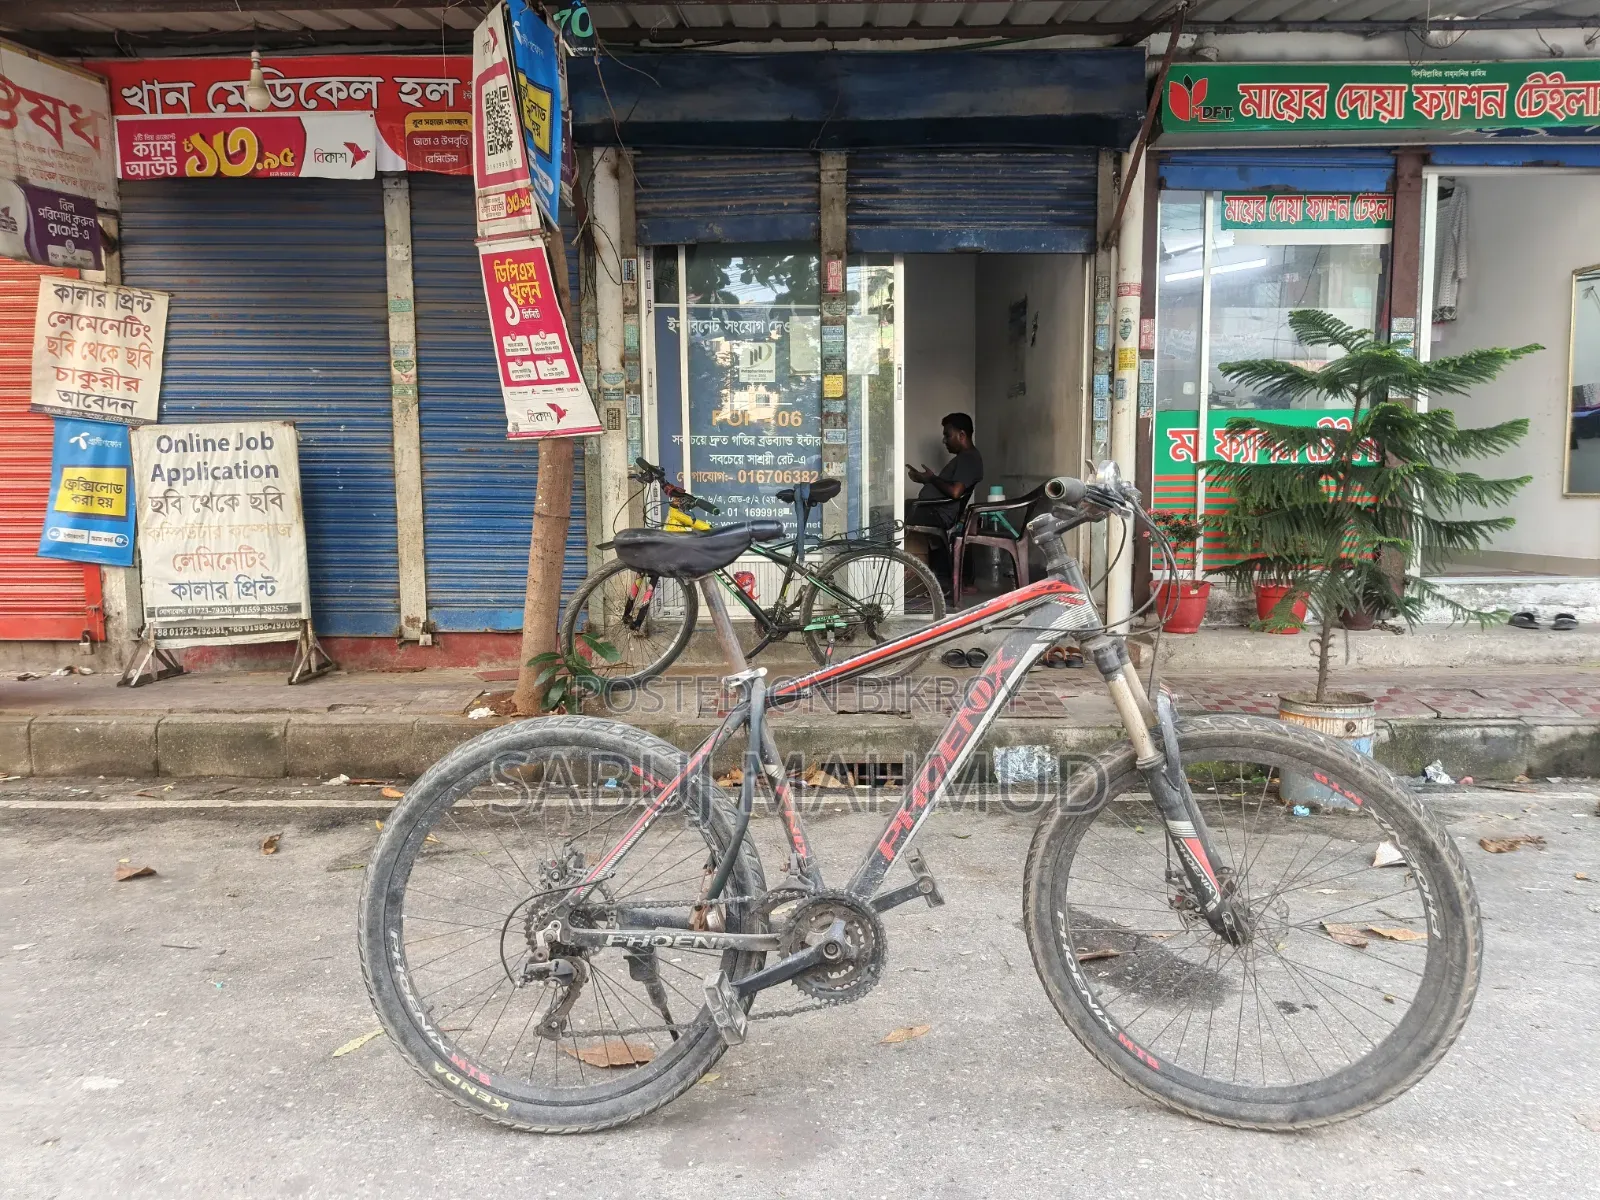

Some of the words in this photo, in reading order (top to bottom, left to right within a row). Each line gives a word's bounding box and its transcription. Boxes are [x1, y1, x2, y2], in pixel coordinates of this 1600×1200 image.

[121, 79, 196, 115] খান
[393, 77, 461, 108] হল
[1238, 83, 1329, 123] মায়ের
[1335, 83, 1408, 123] দোয়া
[1411, 83, 1509, 120] ফ্যাশন
[133, 141, 176, 157] ক্যাশ
[313, 148, 347, 163] বিকাশ
[125, 157, 177, 176] আউট
[38, 207, 71, 224] পরিশোধ
[72, 214, 95, 228] করুন
[59, 198, 75, 213] বিল
[1224, 195, 1267, 224] মায়ের
[1270, 195, 1304, 223] দোয়া
[1306, 194, 1351, 222] ফ্যাশন
[47, 222, 90, 241] রকেট-এ
[494, 258, 536, 283] ডিপিএস
[53, 283, 107, 309] কালার
[113, 288, 155, 314] প্রিন্ট
[509, 281, 541, 305] খুলুন
[48, 311, 152, 343] লেমেনেটিং
[724, 318, 766, 334] সংযোগ
[45, 331, 76, 360] ছবি
[81, 341, 120, 364] থেকে
[125, 342, 153, 370] ছবি
[51, 366, 143, 394] চাকুরীর
[56, 389, 138, 416] আবেদন
[527, 409, 553, 422] বিকাশ
[778, 410, 803, 427] 06
[156, 432, 230, 454] Online
[235, 431, 275, 452] Job
[709, 434, 729, 447] দ্রুত
[732, 432, 756, 446] গতির
[709, 453, 744, 465] সবচেয়ে
[747, 451, 774, 465] সাশ্রয়ী
[777, 453, 806, 465] রেট-এ
[151, 460, 280, 487] Application
[71, 493, 93, 506] করা
[97, 496, 114, 508] হয়
[149, 489, 184, 517] ছবি
[190, 492, 240, 513] থেকে
[248, 486, 285, 514] ছবি
[173, 545, 271, 572] লেমিনেটিং
[169, 580, 228, 601] কালার
[235, 574, 278, 599] প্রিন্ট
[1056, 910, 1118, 1033] PHOENIX
[389, 927, 451, 1054] PHOENIX
[1118, 1031, 1161, 1070] MTB
[450, 1052, 492, 1087] MTB
[433, 1060, 510, 1112] KENDA
